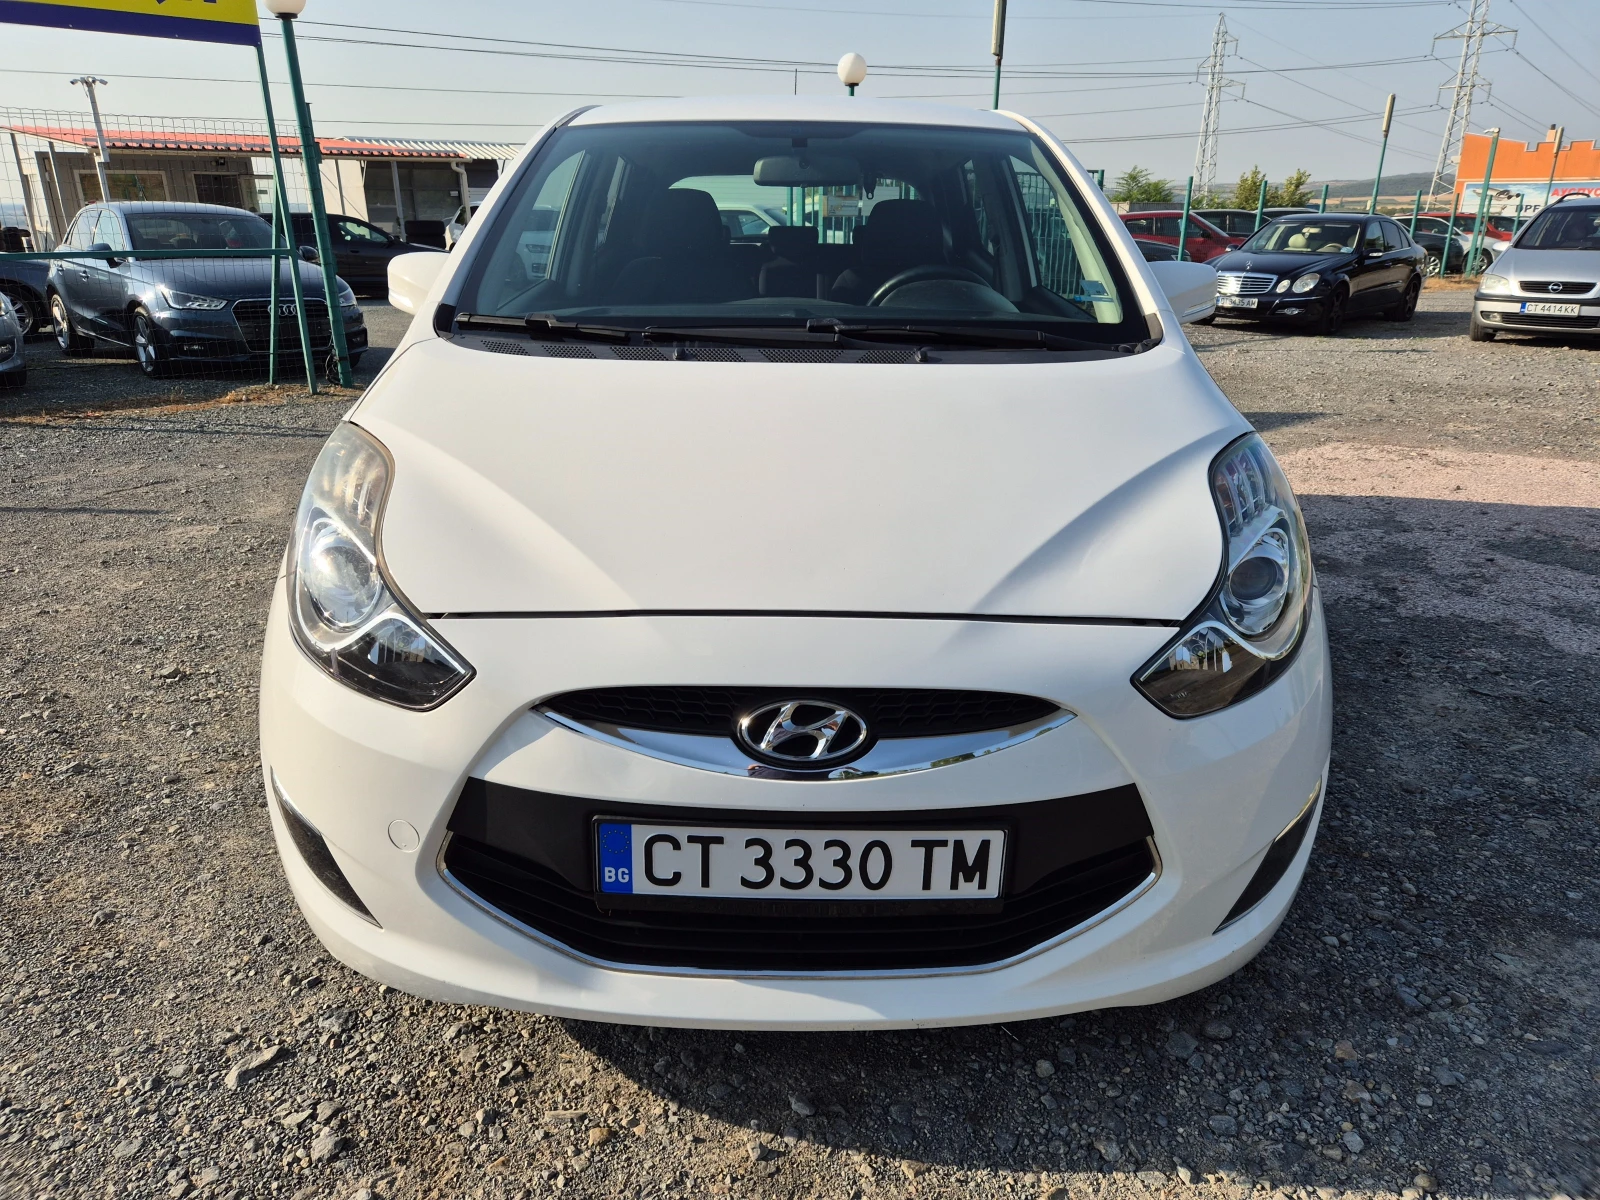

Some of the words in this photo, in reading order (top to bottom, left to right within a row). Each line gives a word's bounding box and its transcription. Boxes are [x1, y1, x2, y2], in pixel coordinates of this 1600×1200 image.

[1527, 303, 1539, 312] CT
[643, 833, 725, 888] CT
[740, 837, 893, 891] 3330
[911, 839, 991, 891] TM
[604, 866, 630, 883] BG
